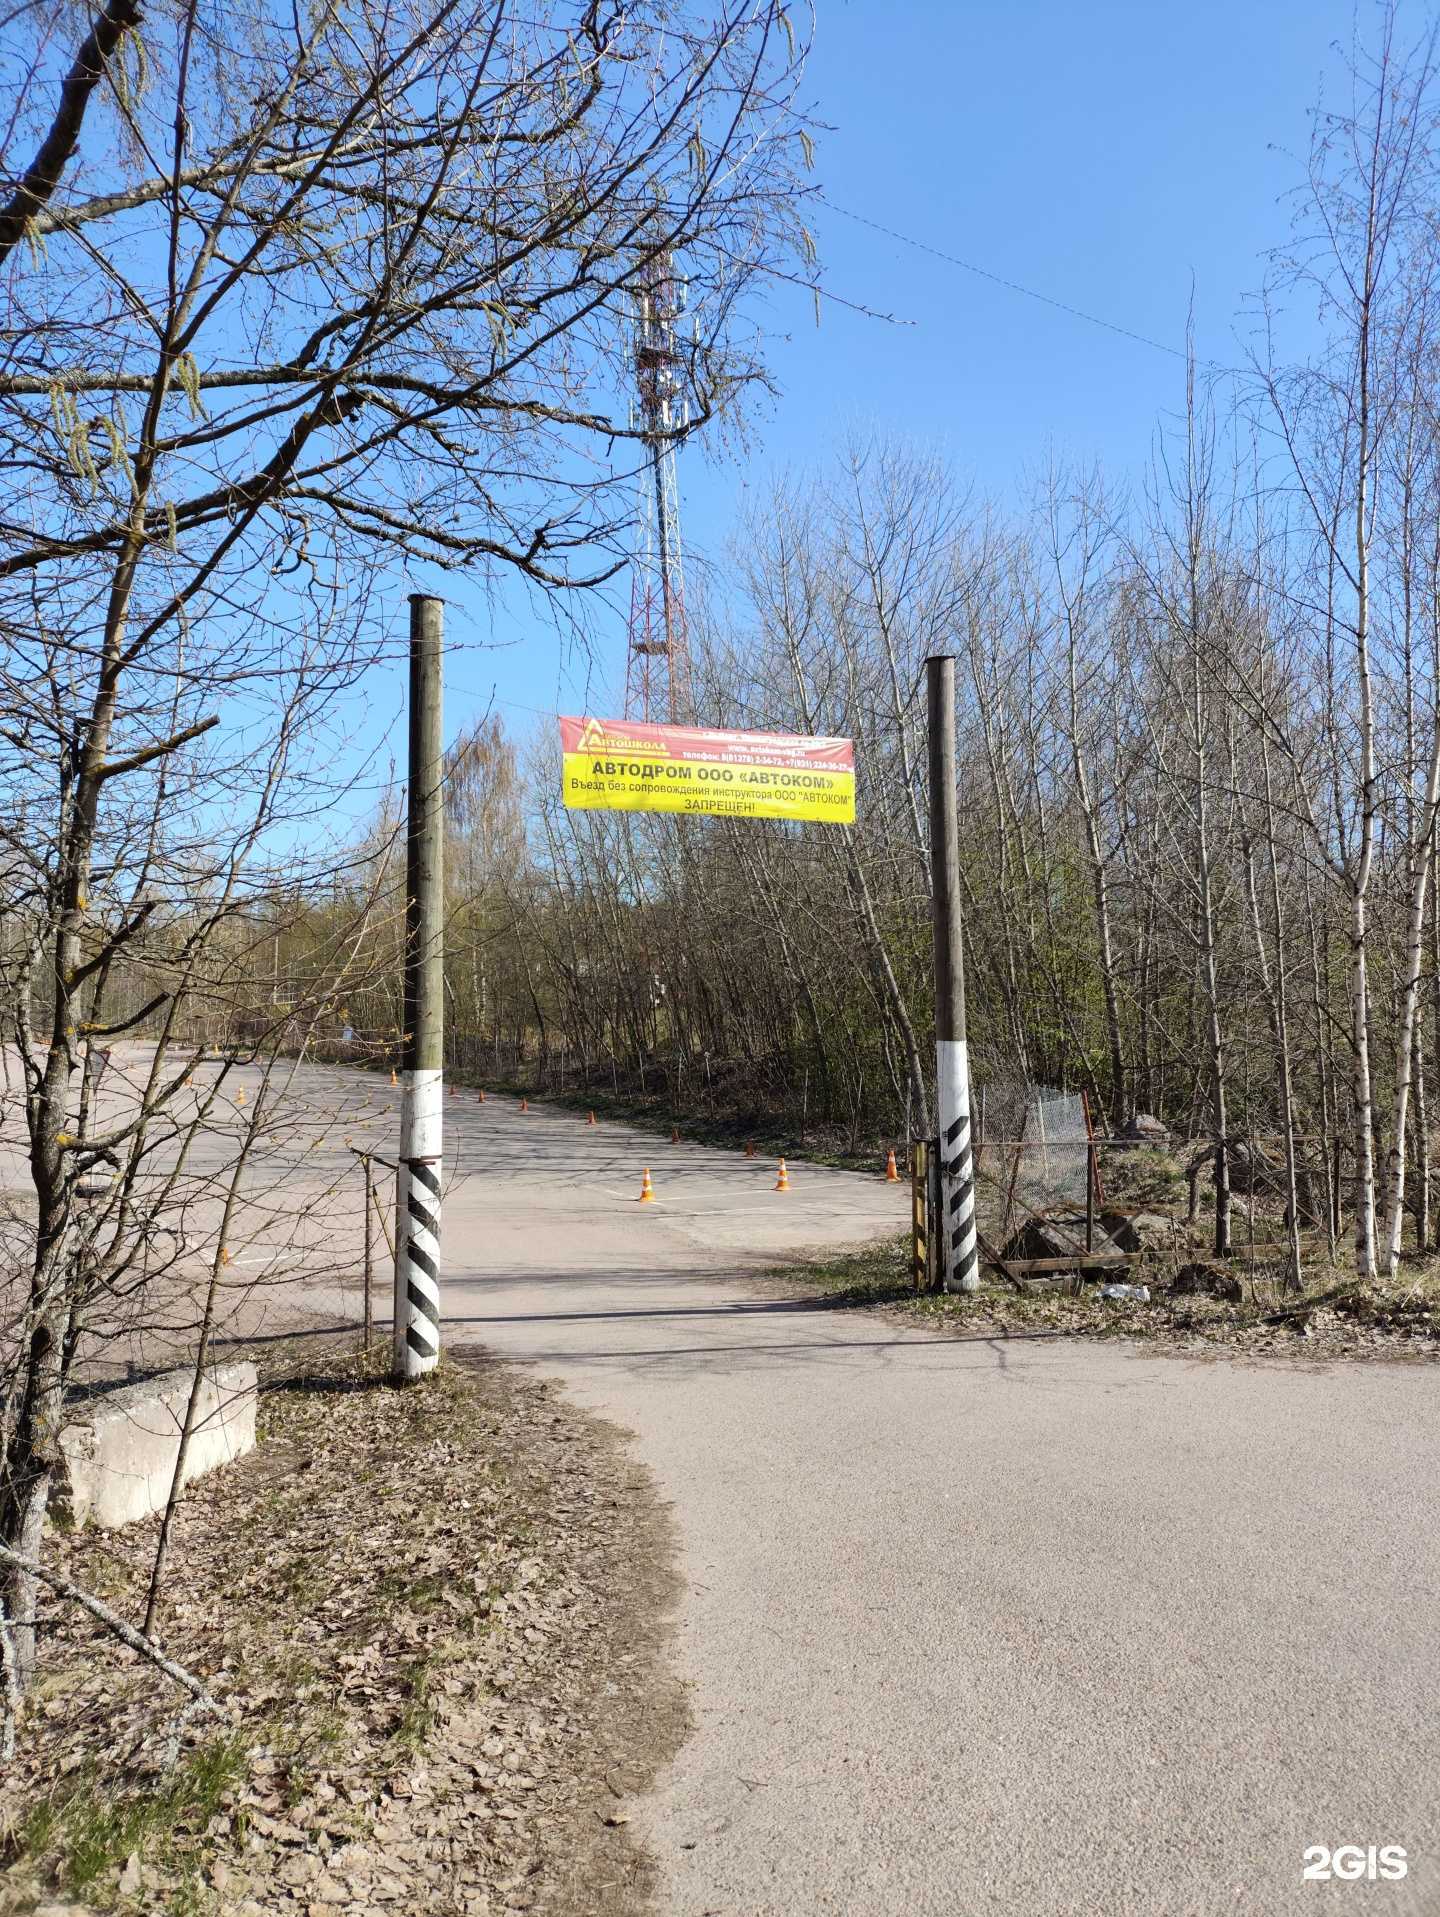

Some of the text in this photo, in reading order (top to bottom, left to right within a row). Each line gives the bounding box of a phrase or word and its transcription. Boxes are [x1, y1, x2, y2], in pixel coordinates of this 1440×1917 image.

[592, 761, 834, 789] АВТОДРОМ ООО «АВТОКОМ»
[571, 777, 851, 806] Въезд без сопровождения инструктора ООО "АВТОКОМ"
[685, 799, 755, 813] ЗАПРЕЩЕН!
